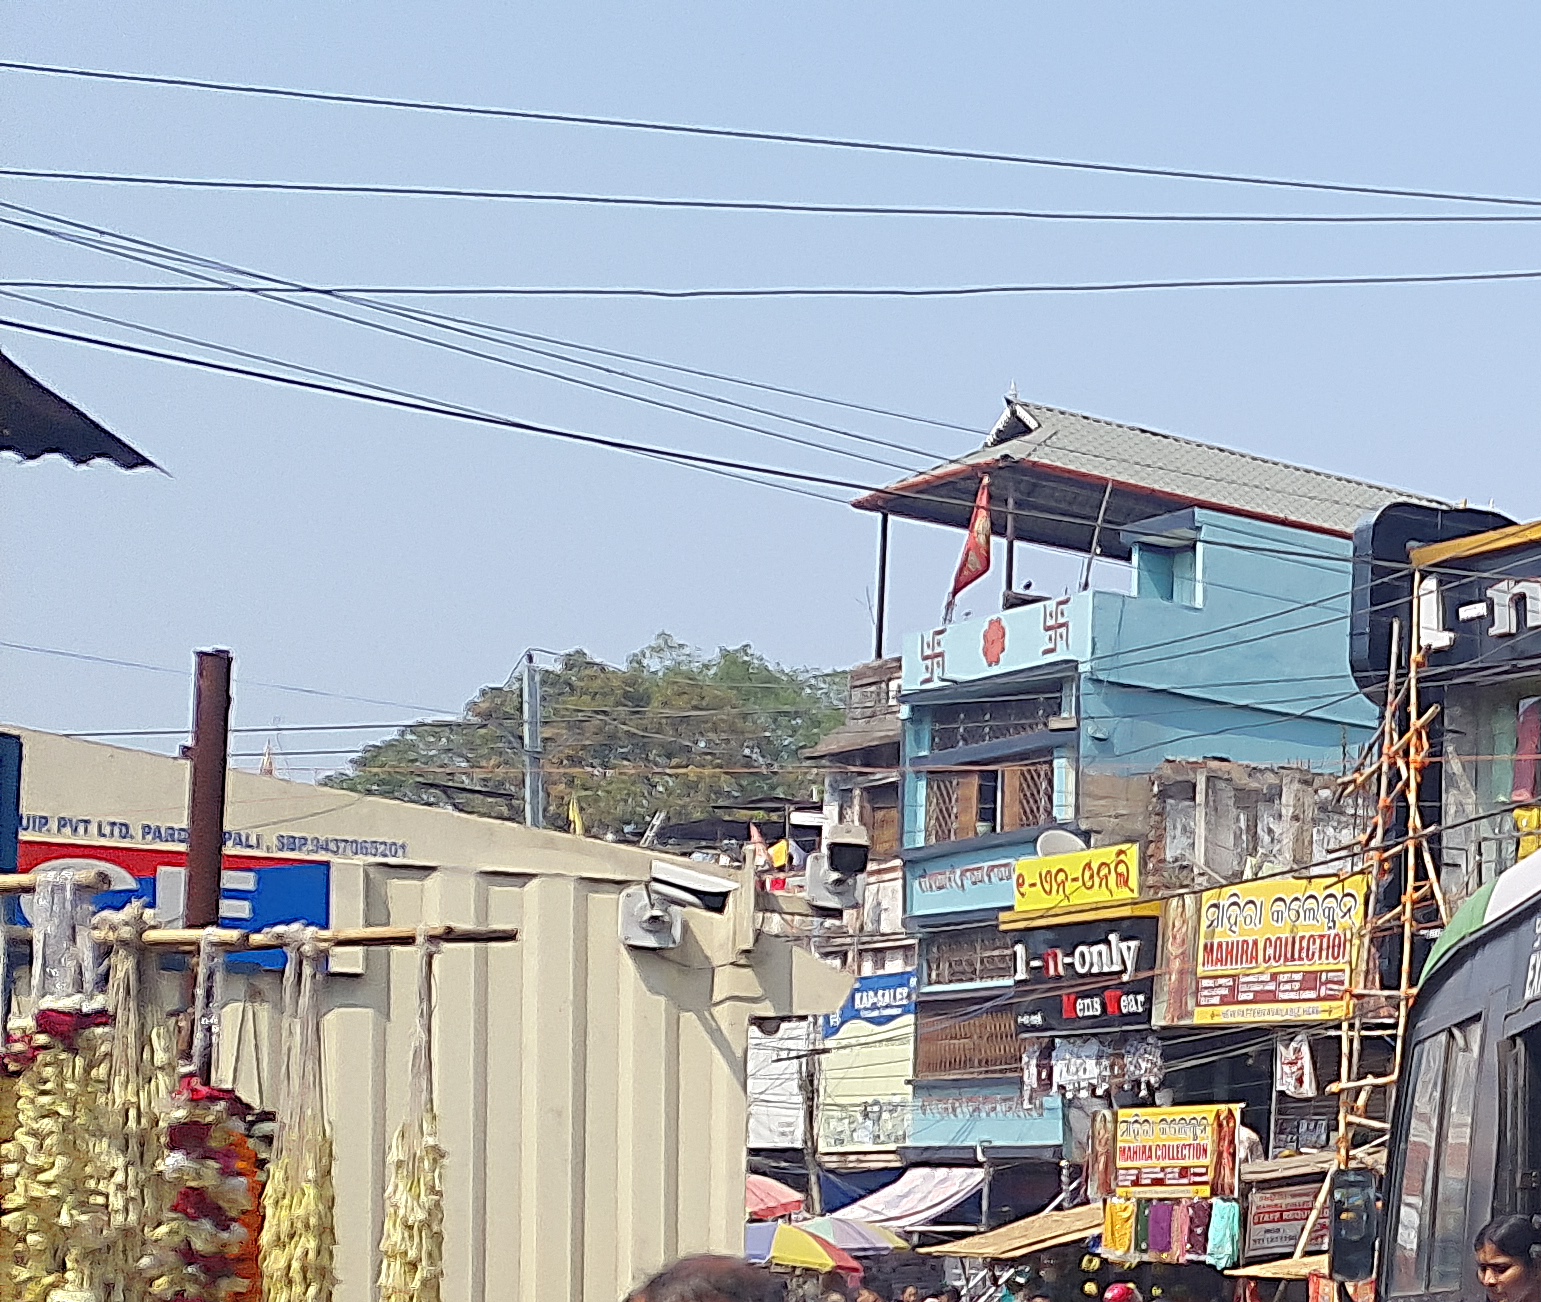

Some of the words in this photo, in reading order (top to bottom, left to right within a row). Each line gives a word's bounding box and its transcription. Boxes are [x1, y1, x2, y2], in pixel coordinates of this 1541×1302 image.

[56, 817, 92, 838] PVT
[97, 820, 134, 841] LTD.
[1202, 938, 1259, 969] MAHIRA
[1118, 1143, 1153, 1163] MAHIRA
[1154, 1141, 1209, 1162] COLLECTION
